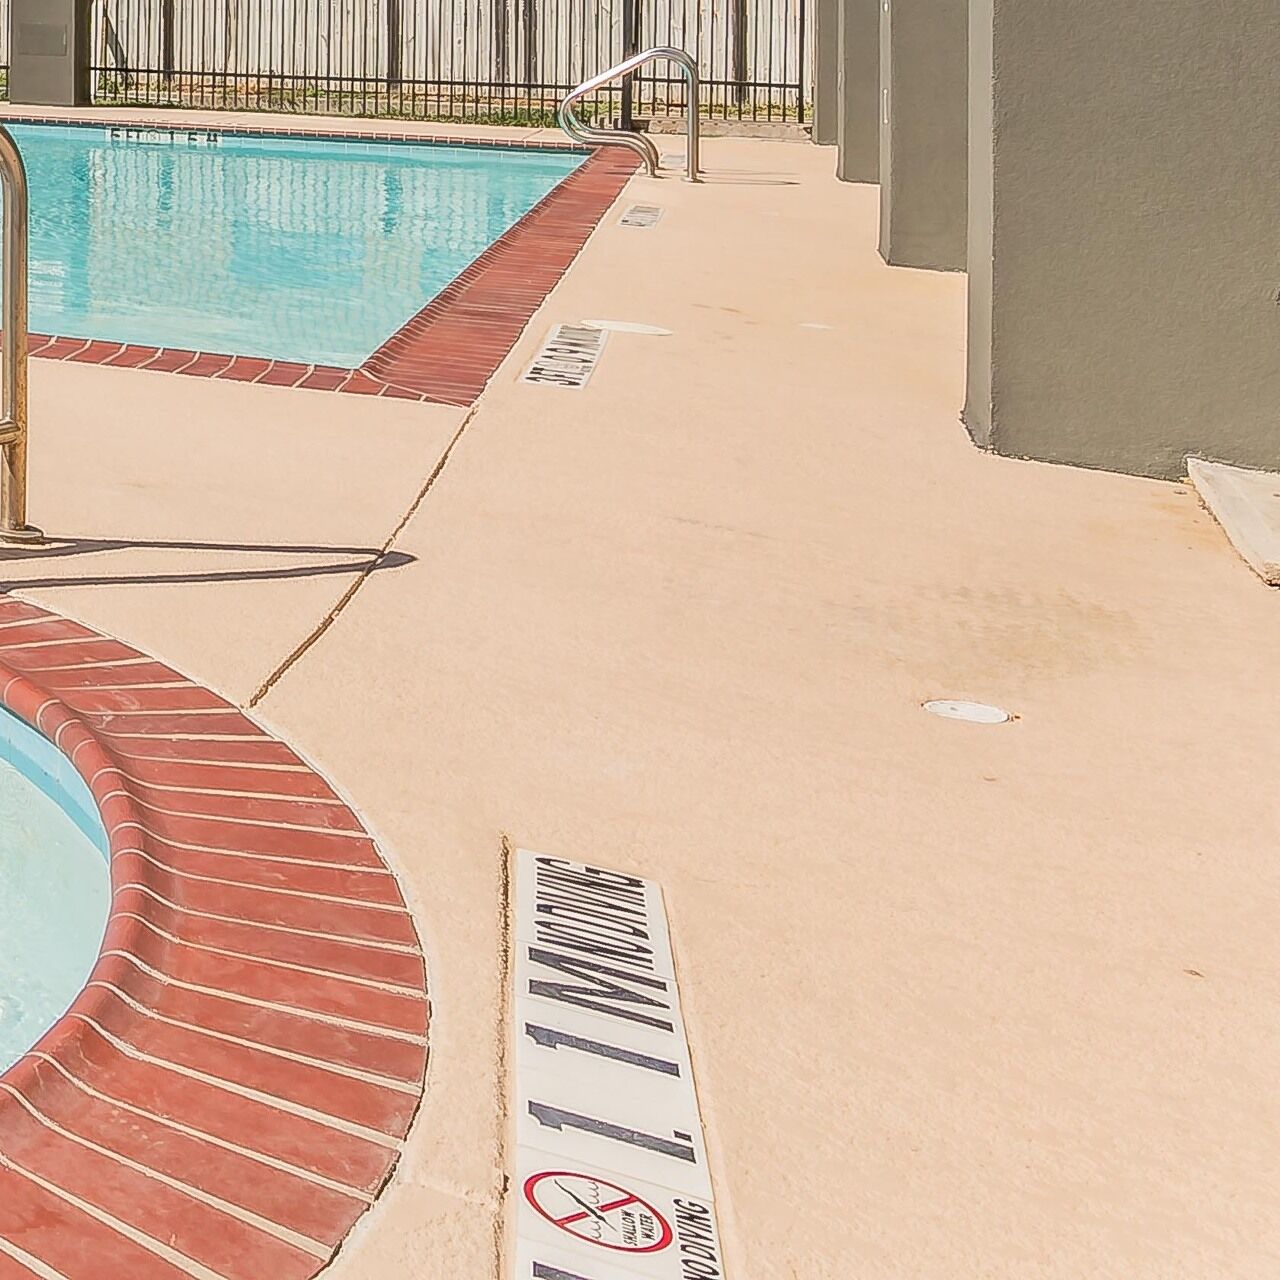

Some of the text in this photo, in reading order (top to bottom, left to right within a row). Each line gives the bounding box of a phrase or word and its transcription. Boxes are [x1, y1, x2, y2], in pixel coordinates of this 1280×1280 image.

[535, 857, 649, 940] DIVING
[534, 921, 654, 970] NO
[528, 946, 674, 1033] M
[621, 1209, 638, 1246] SHALLOW
[639, 1213, 655, 1240] WATER
[673, 1198, 718, 1263] DIVING
